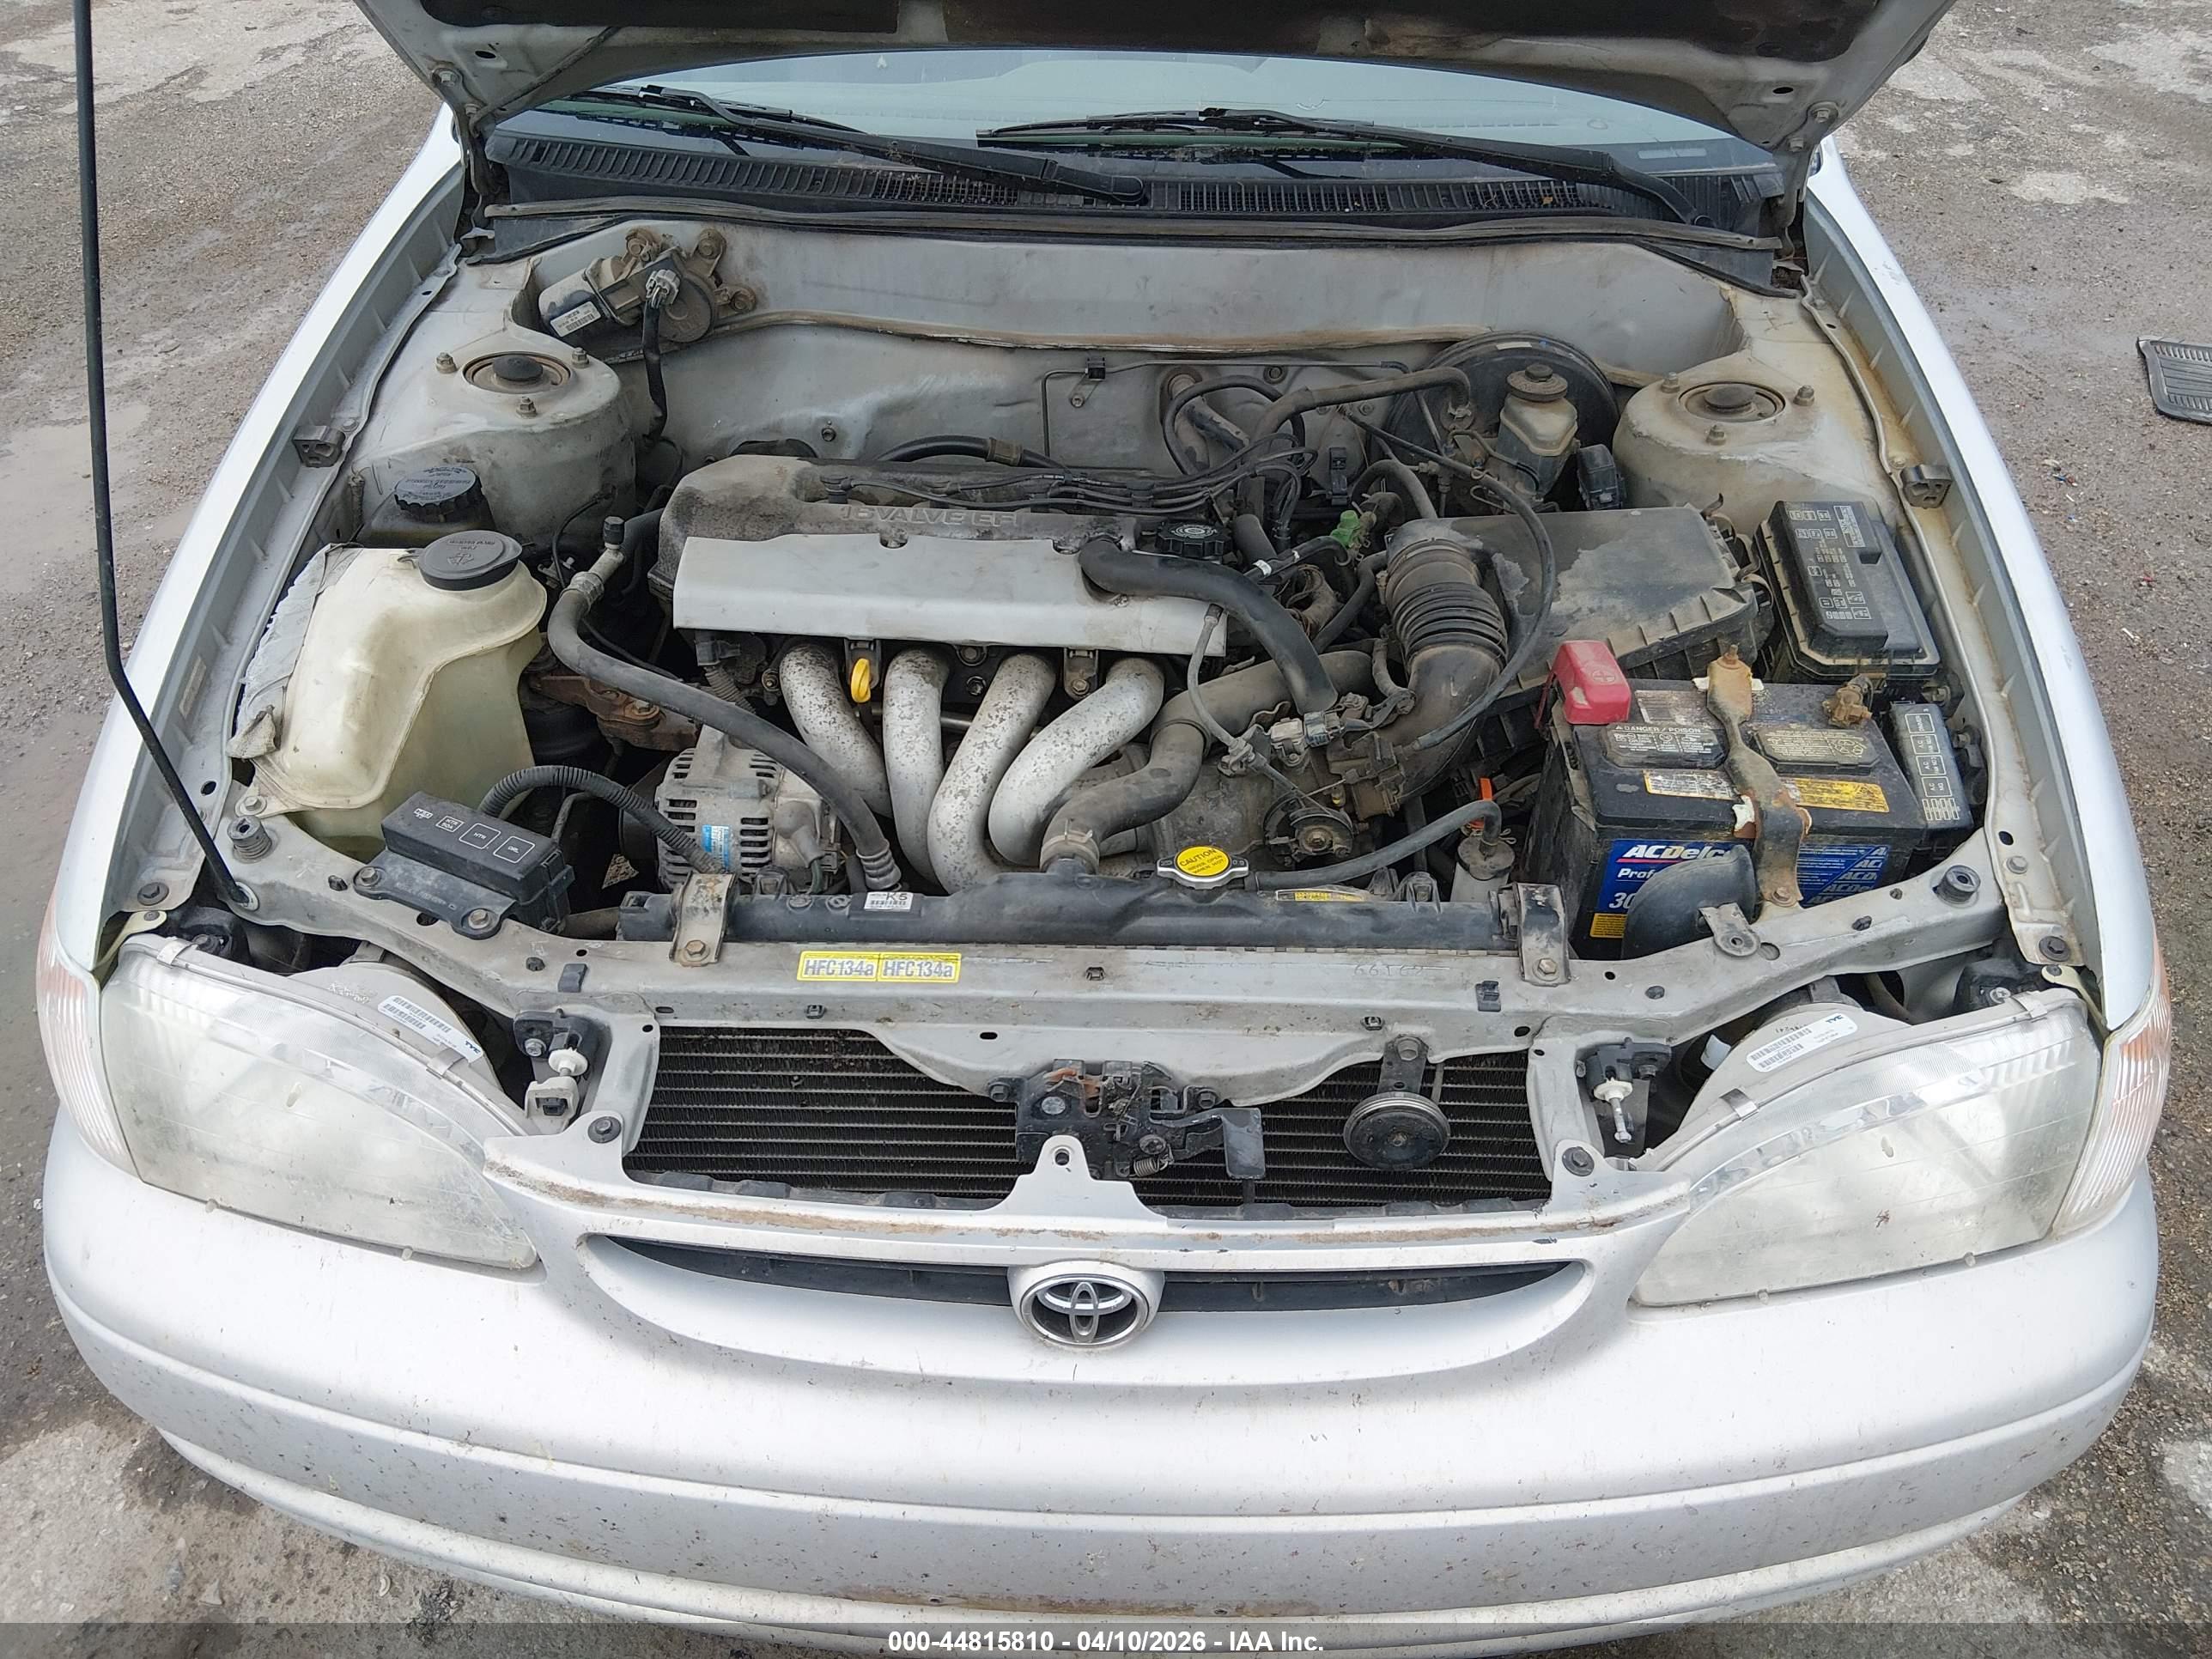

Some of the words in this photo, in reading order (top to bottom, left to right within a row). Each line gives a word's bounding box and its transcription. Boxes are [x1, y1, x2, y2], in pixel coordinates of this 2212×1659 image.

[1179, 848, 1218, 866] CAUTION
[1622, 844, 1731, 860] ACDelc
[1188, 861, 1207, 871] NEVER
[1206, 854, 1224, 864] OPEN
[1211, 858, 1225, 867] HOT
[804, 959, 875, 976] HFC134a
[883, 961, 953, 978] HFC134a
[465, 1041, 481, 1054] TYC
